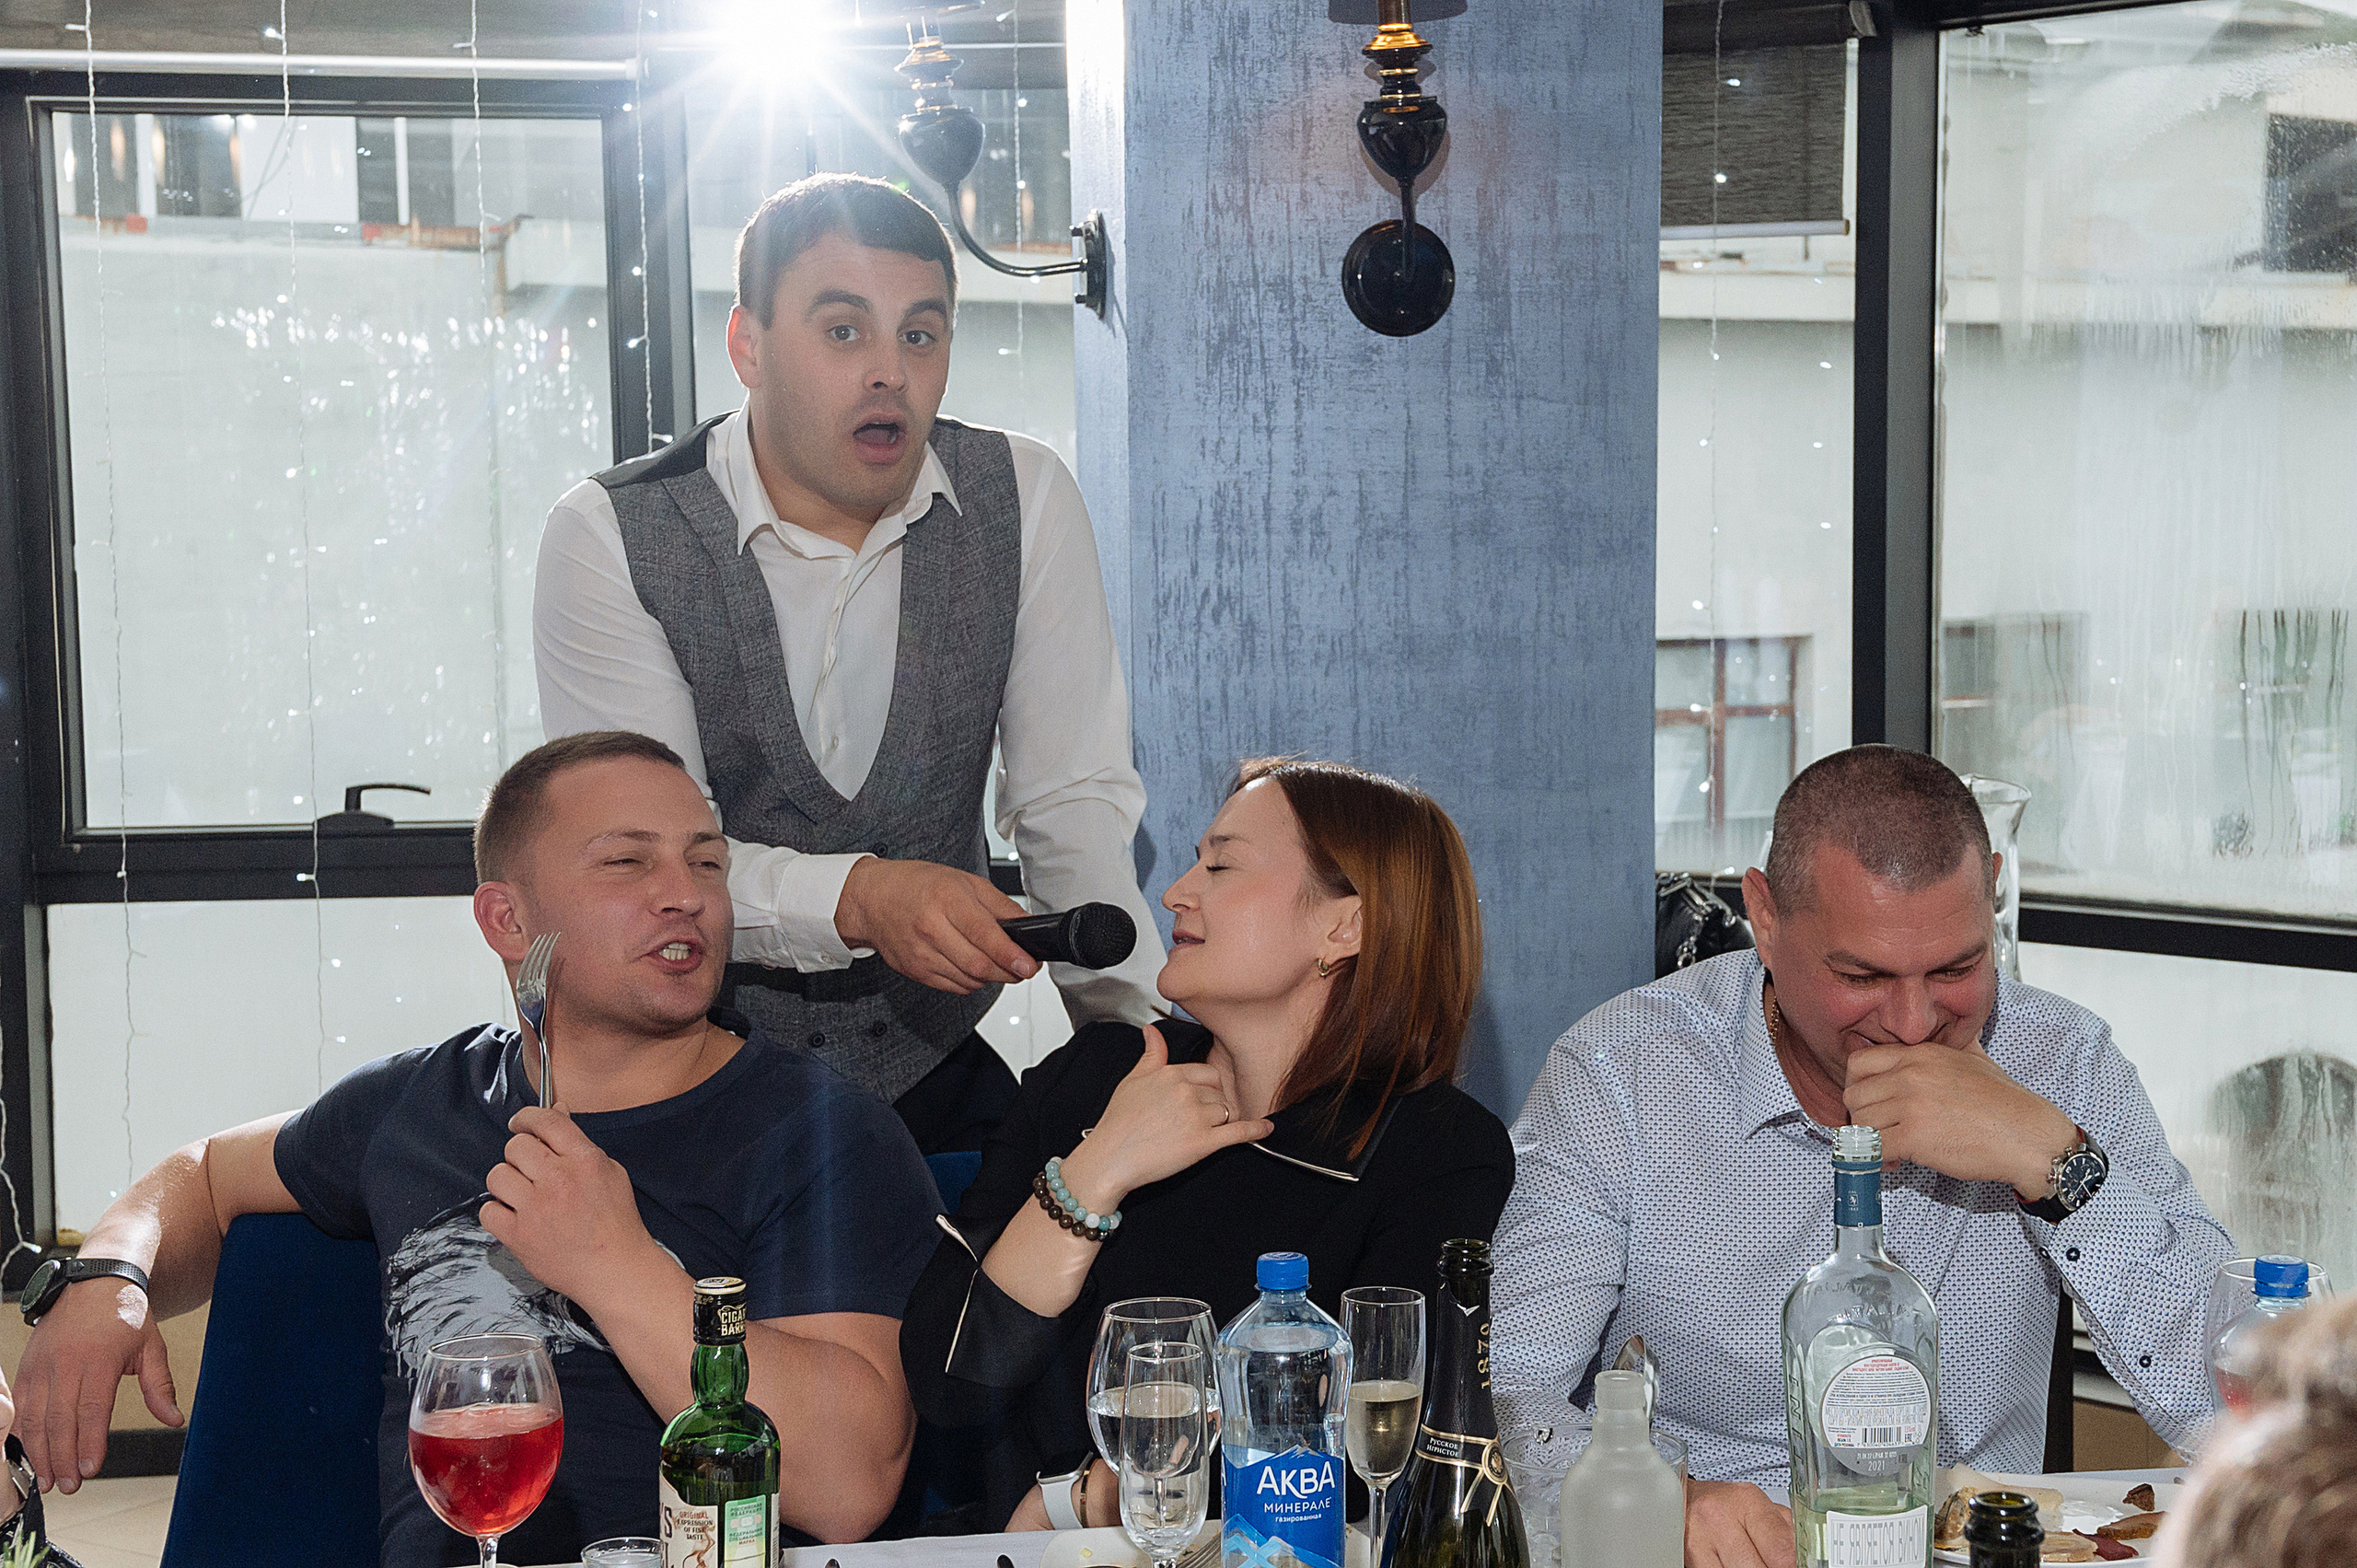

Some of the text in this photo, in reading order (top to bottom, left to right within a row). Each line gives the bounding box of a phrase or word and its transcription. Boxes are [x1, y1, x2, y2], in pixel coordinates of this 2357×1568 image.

[1867, 1460, 1886, 1471] 2021
[1256, 1460, 1336, 1499] АКВА
[1264, 1498, 1331, 1514] МИНЕРАЛЕ
[679, 1510, 709, 1519] ORIGINAL
[1275, 1513, 1322, 1523] газированная
[1832, 1523, 1844, 1565] НЕ
[1849, 1521, 1895, 1565] ЯВЛЯЕТСЯ
